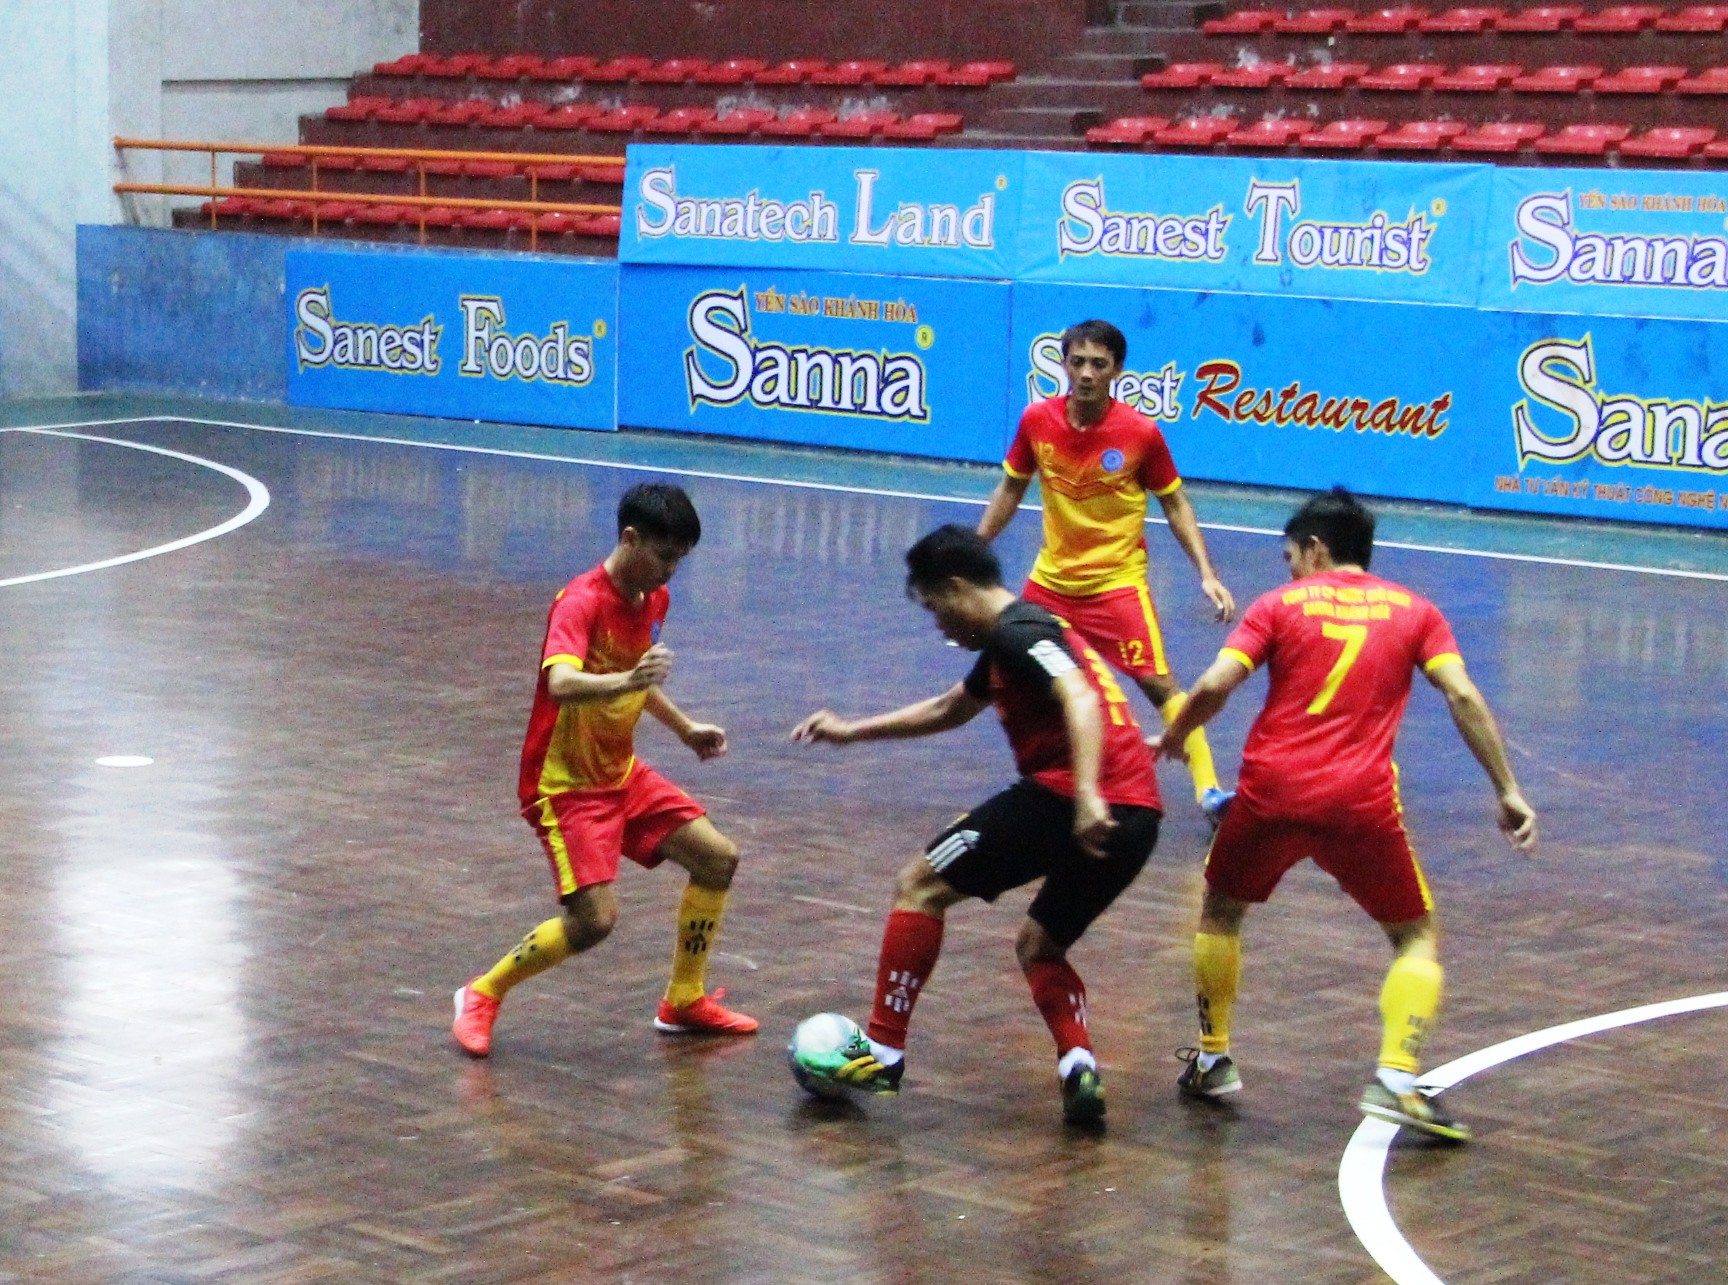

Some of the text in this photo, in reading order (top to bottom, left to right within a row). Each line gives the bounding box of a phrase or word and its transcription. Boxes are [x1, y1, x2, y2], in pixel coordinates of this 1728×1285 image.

[636, 164, 996, 248] Sanatech Land
[1056, 175, 1438, 275] Sanest Tourist
[1509, 187, 1728, 292] Sanna
[294, 283, 594, 386] Sanest Foods
[755, 285, 786, 313] YẾN
[789, 290, 820, 315] SÀO
[823, 293, 880, 320] KHÁNH
[684, 283, 930, 424] Sanna
[1027, 329, 1452, 440] Sest Restaurant
[1118, 640, 1146, 666] 12
[1306, 621, 1368, 715] 7
